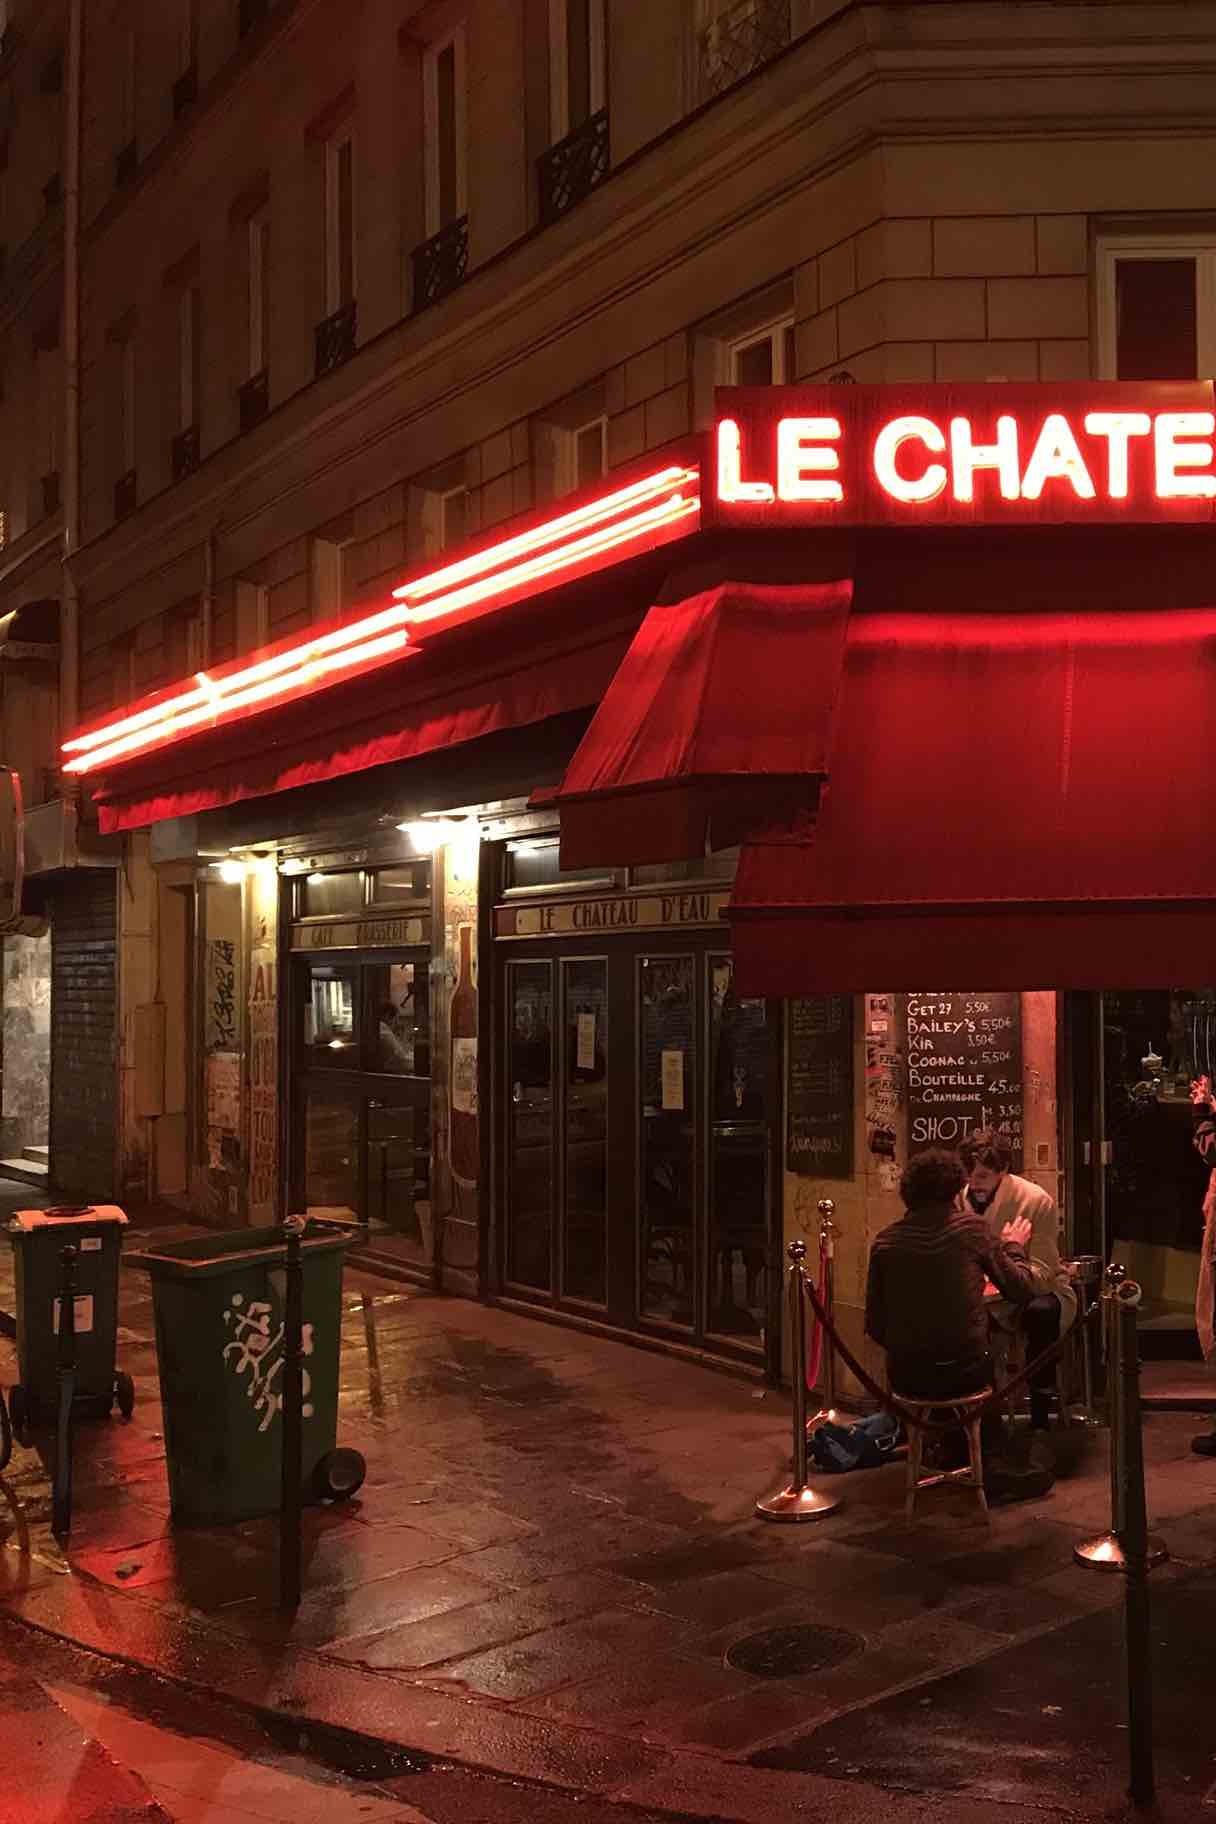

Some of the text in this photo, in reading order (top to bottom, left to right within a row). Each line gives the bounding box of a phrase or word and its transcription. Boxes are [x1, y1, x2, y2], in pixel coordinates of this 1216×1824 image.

[716, 415, 845, 504] LE
[539, 893, 710, 931] LE CHATEAU D'EAU
[938, 1002, 951, 1015] 27
[911, 1115, 976, 1142] SHOT
